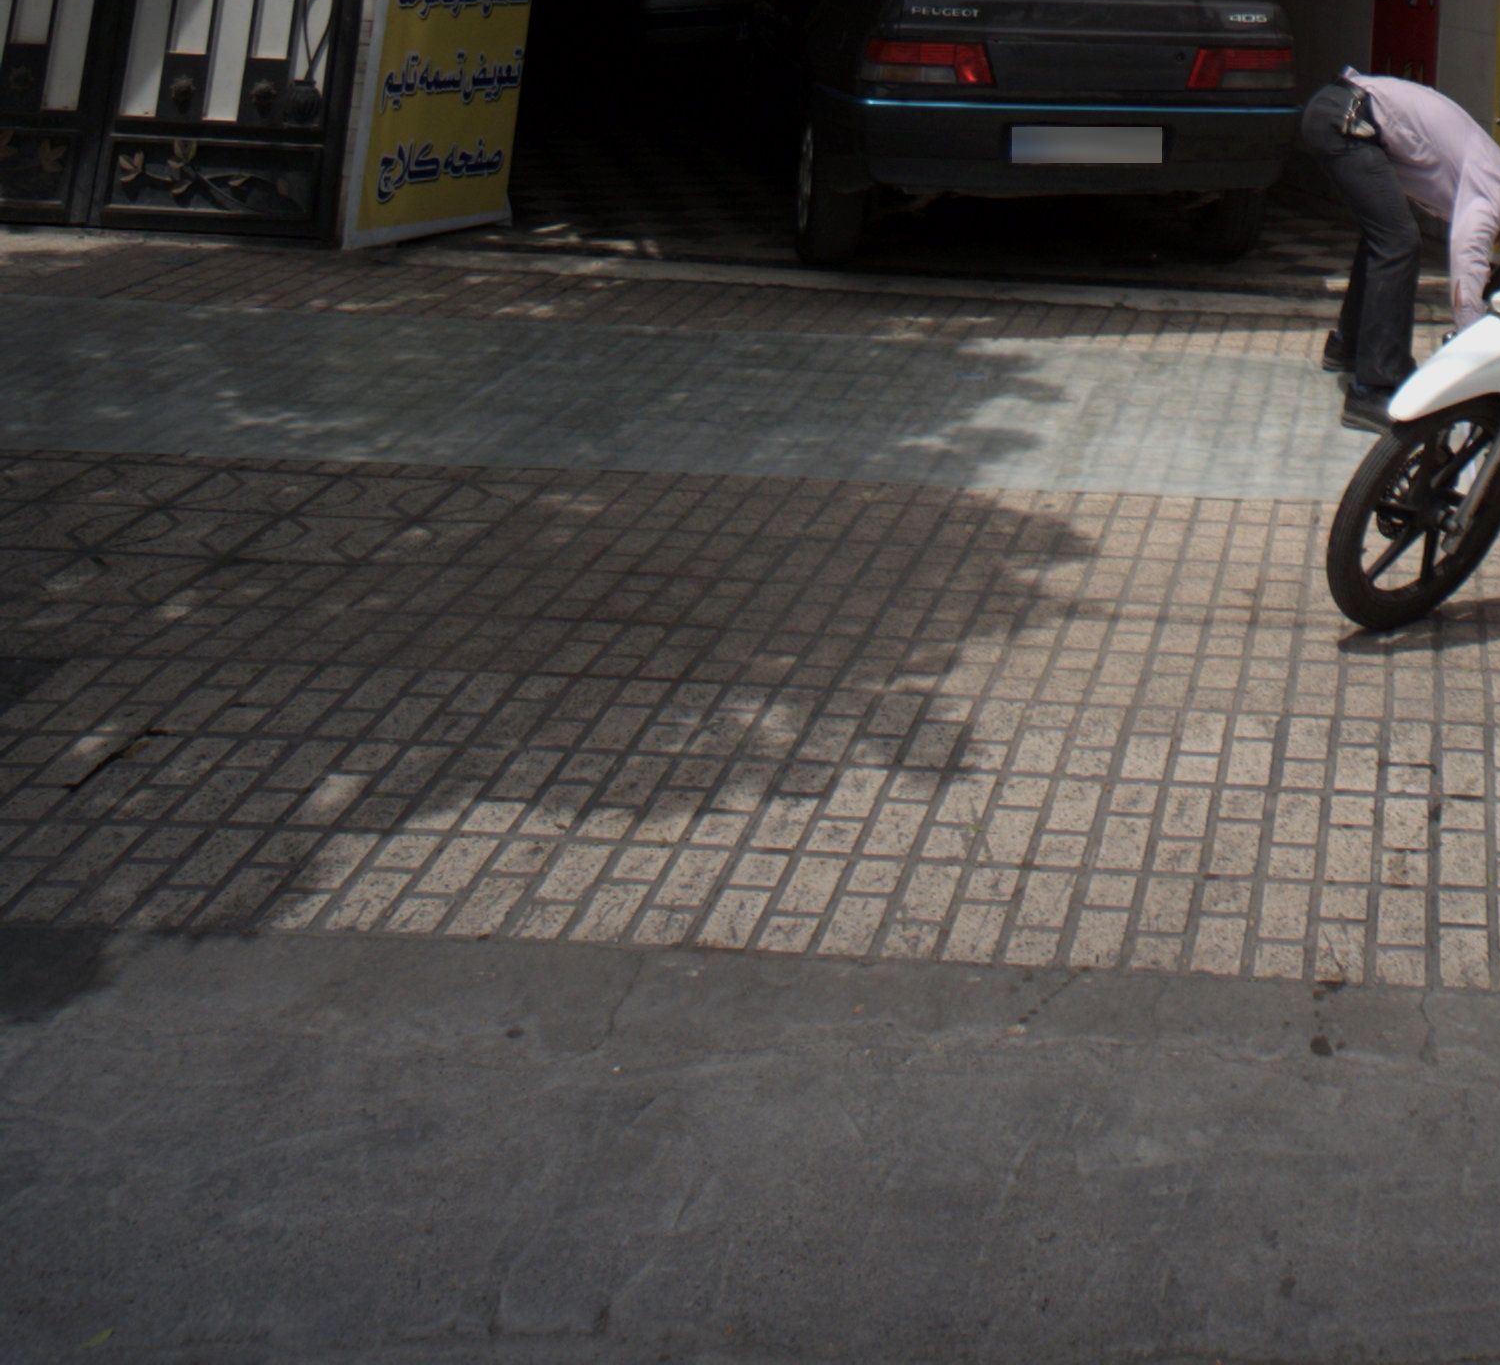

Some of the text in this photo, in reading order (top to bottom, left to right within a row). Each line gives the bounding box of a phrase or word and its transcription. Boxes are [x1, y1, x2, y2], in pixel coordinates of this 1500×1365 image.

[911, 5, 979, 19] PEUGEOT
[420, 50, 465, 94] تسمه
[462, 48, 525, 103] تعویض
[377, 139, 505, 204] صفحه کلاچ
